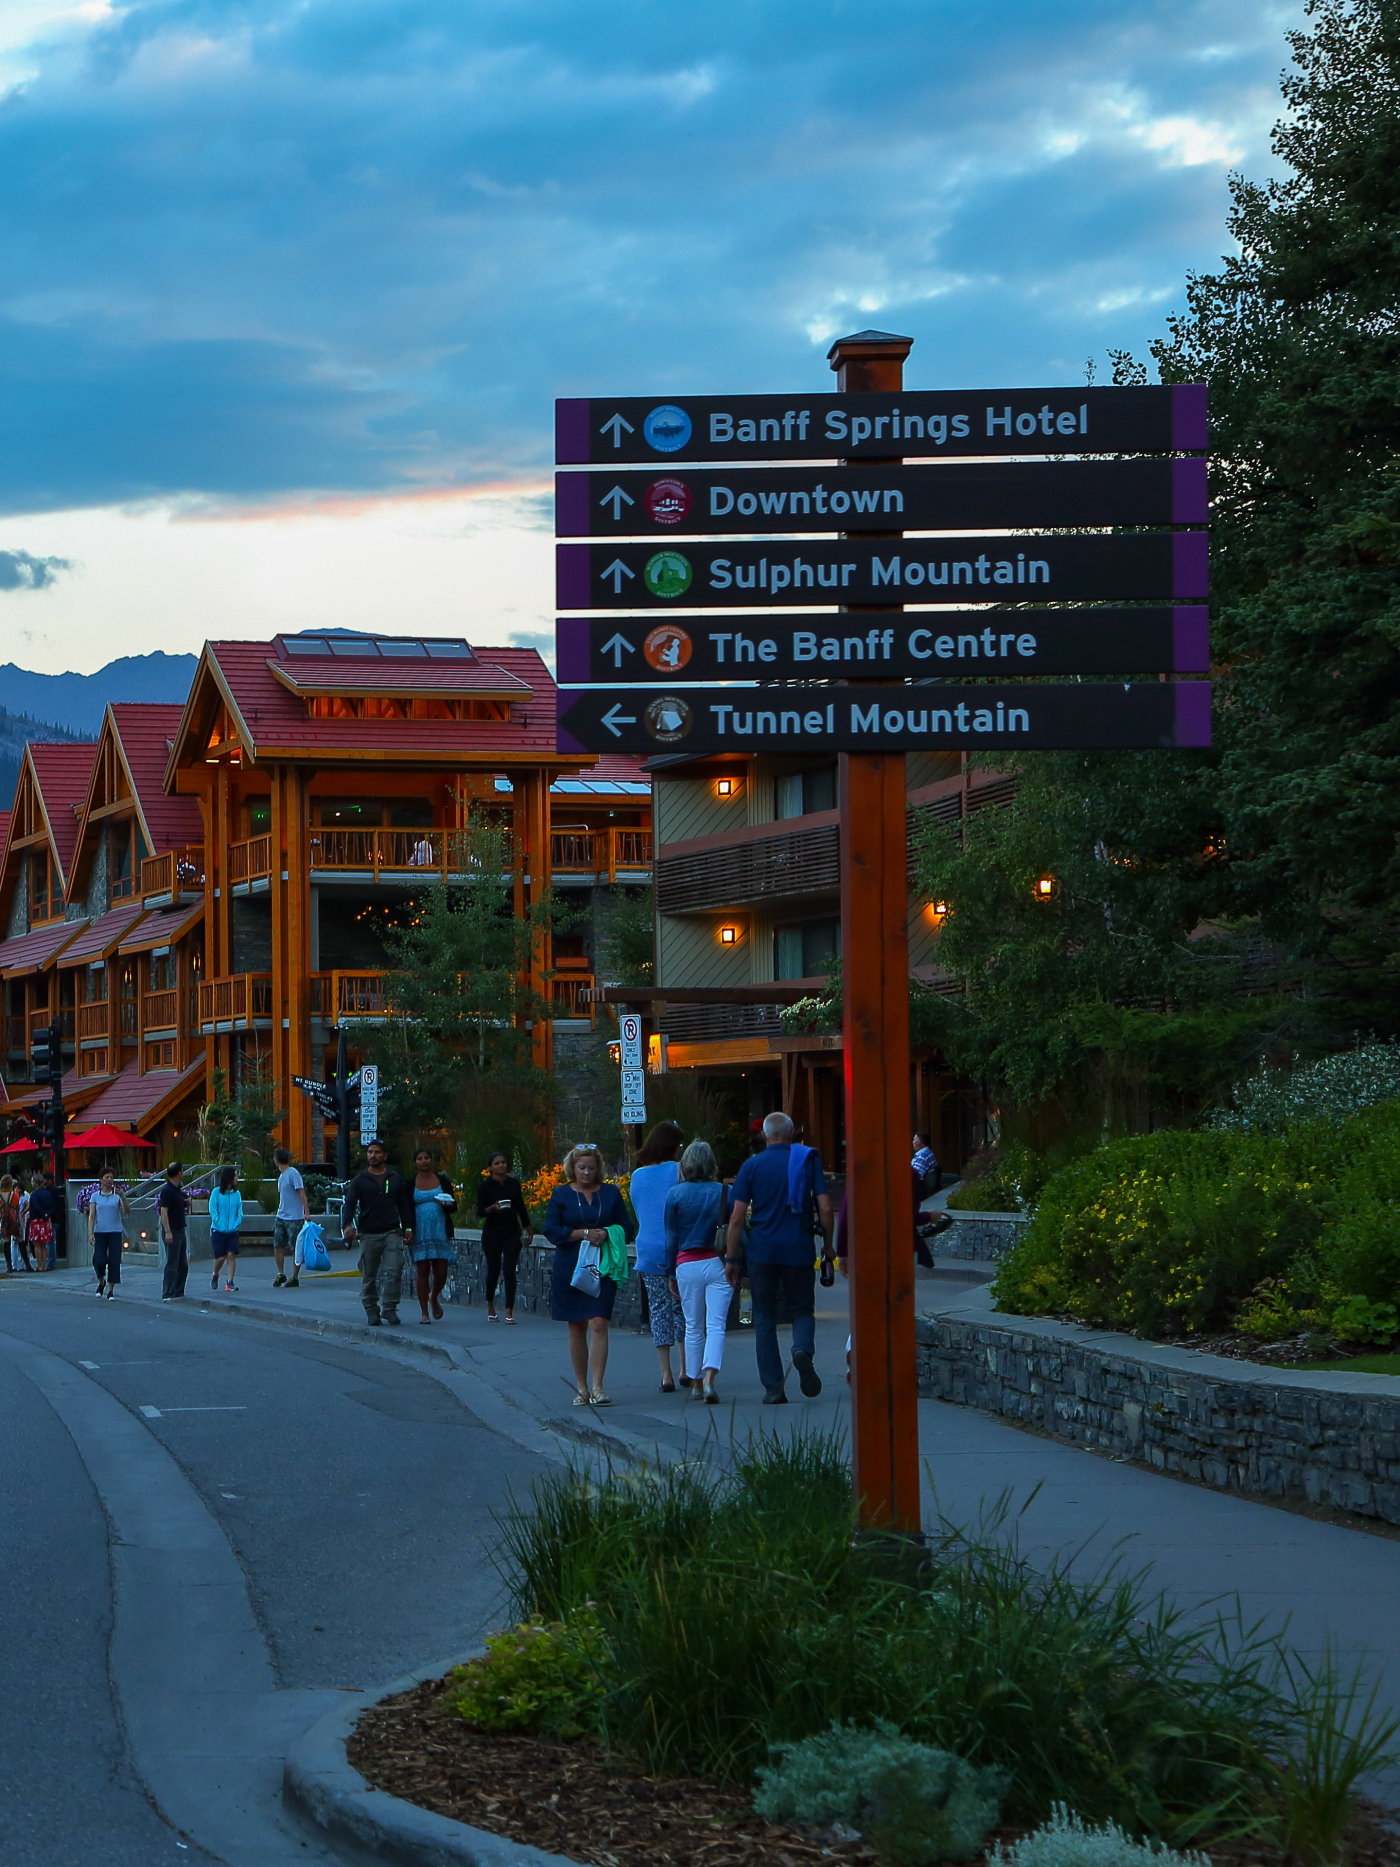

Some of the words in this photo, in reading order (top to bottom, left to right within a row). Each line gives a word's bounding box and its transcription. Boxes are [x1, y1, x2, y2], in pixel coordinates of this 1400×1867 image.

[710, 410, 810, 443] Banff
[824, 408, 970, 447] Springs
[986, 403, 1088, 437] Hotel
[710, 483, 904, 517] Downtown
[709, 557, 857, 595] Sulphur
[871, 553, 1050, 587] Mountain
[709, 632, 778, 663] The
[793, 628, 894, 661] Banff
[908, 627, 1037, 659] Centre
[709, 703, 835, 735] Tunnel
[851, 701, 1030, 734] Mountain
